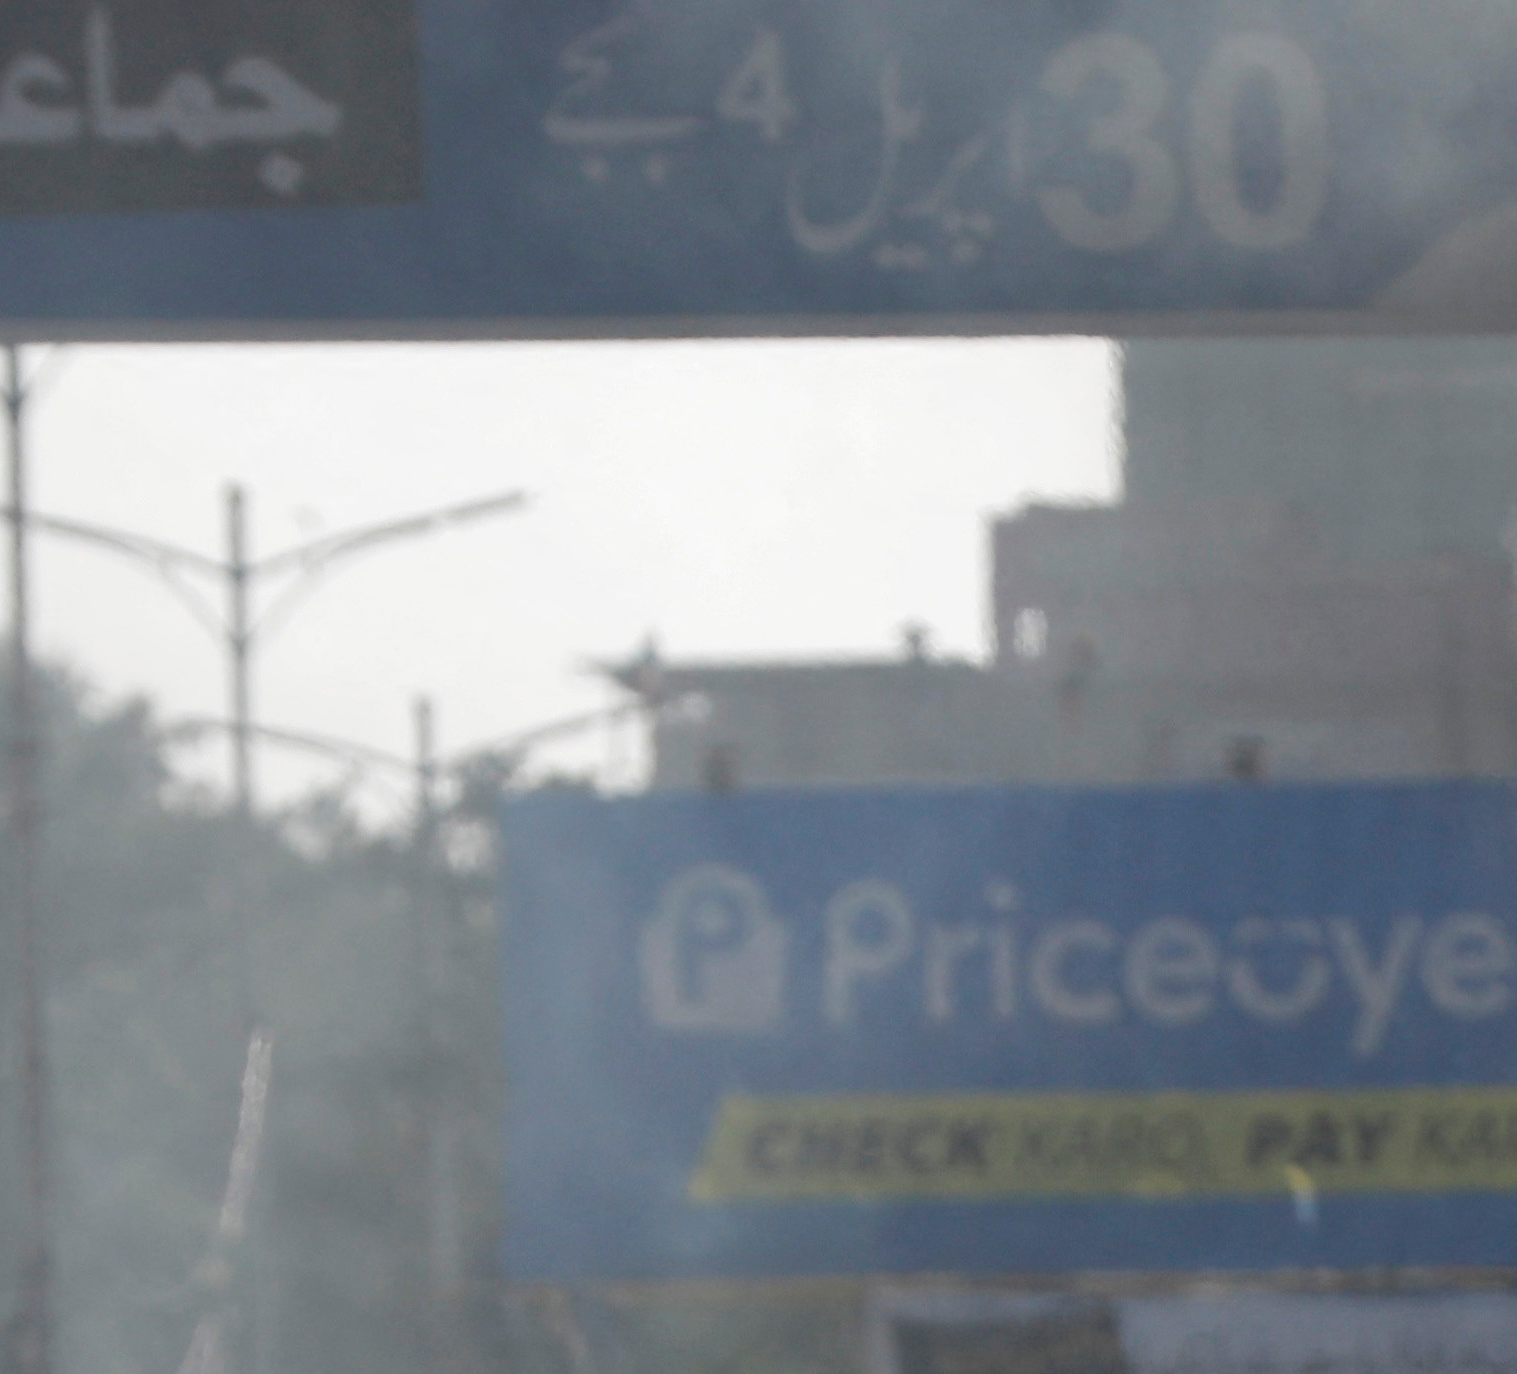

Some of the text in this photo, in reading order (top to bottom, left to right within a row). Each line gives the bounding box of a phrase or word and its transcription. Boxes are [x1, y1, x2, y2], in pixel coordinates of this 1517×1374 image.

[716, 26, 797, 144] 4
[1036, 28, 1327, 255] 30
[745, 1117, 990, 1180] CHECK
[1246, 1108, 1400, 1170] PAY
